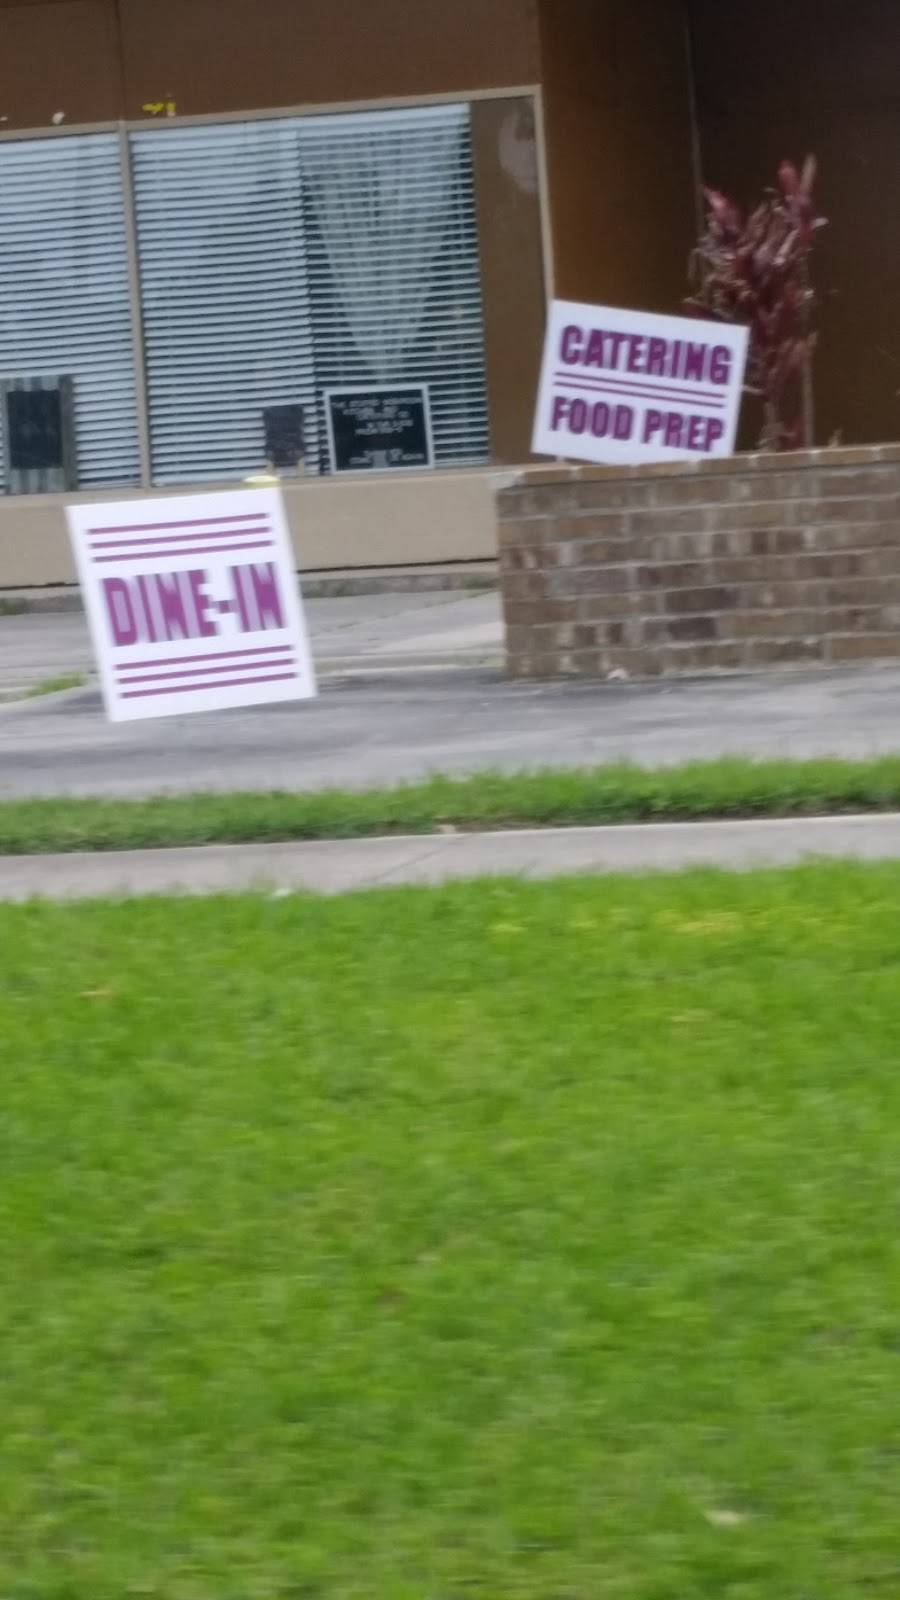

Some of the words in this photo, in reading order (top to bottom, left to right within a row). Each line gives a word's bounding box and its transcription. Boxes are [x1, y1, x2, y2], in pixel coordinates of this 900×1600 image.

[560, 325, 732, 385] CATERING
[550, 396, 634, 441] FOOD
[641, 409, 726, 452] PREP
[101, 561, 286, 647] DINE-IN
